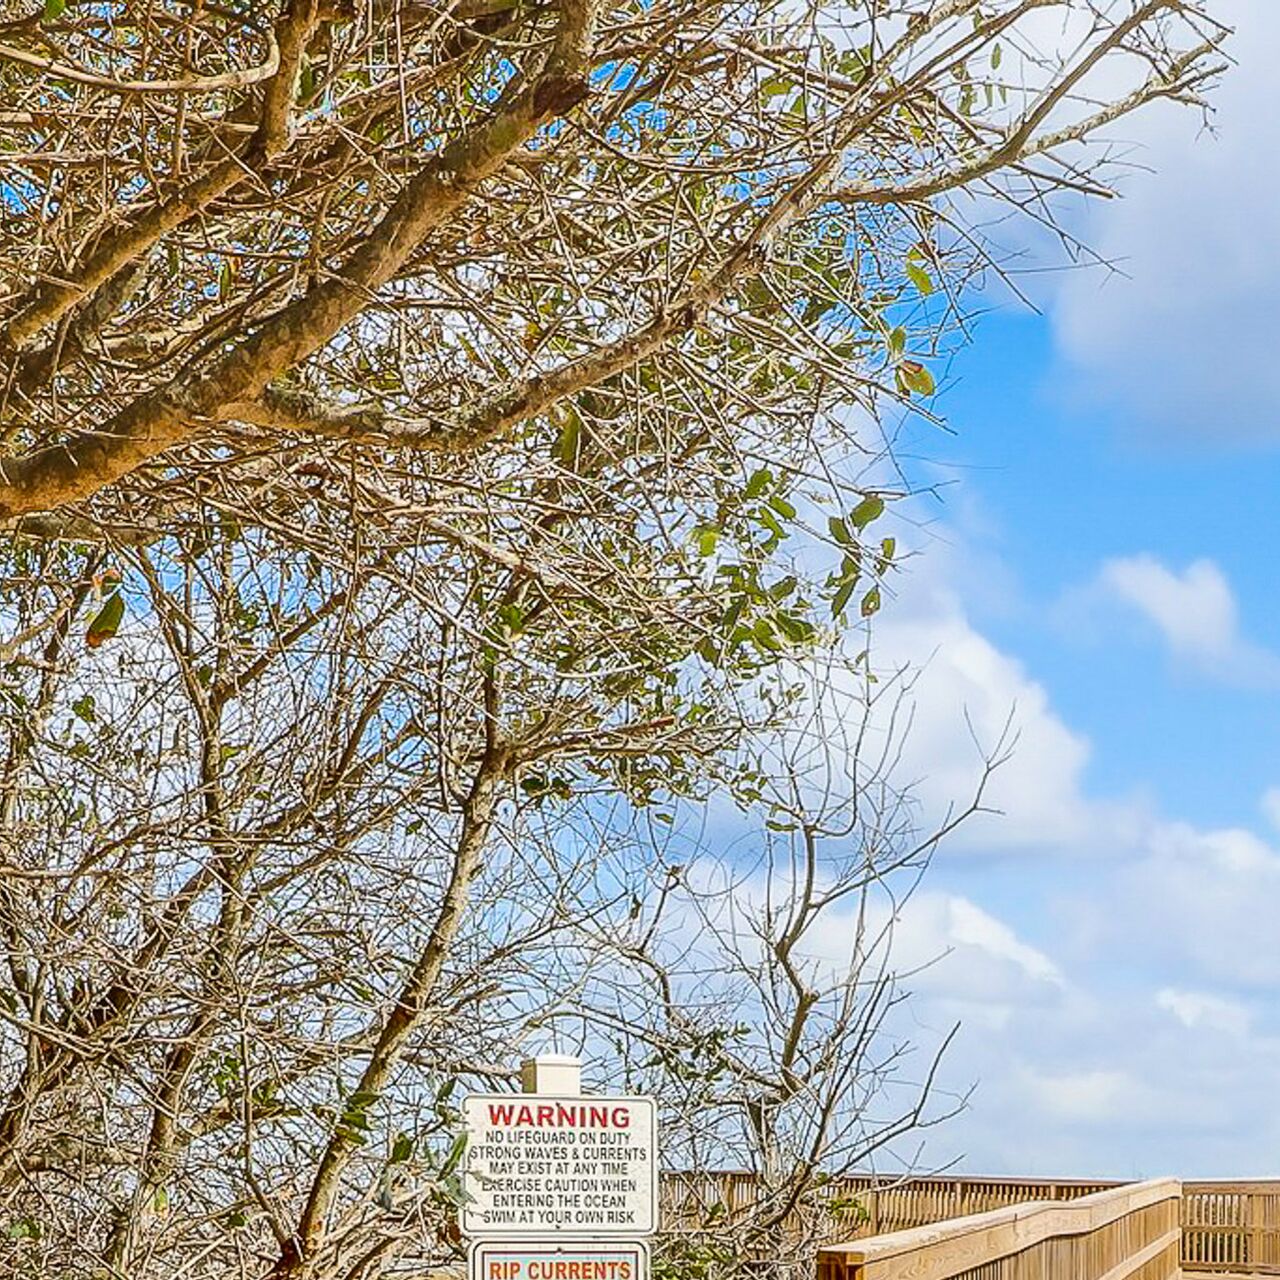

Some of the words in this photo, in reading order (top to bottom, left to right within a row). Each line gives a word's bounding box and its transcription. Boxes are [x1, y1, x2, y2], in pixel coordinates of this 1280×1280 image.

[488, 1104, 630, 1128] WARNING
[486, 1130, 504, 1144] NO
[507, 1131, 575, 1145] LIFEGUARD
[579, 1132, 596, 1145] ON
[600, 1132, 631, 1145] DUTY
[470, 1146, 521, 1160] STRONG
[524, 1147, 568, 1160] WAVES
[572, 1148, 580, 1160] &
[582, 1147, 647, 1161] CURRENTS
[489, 1162, 515, 1175] MAY
[518, 1162, 552, 1175] EXIST
[555, 1162, 570, 1175] AT
[574, 1162, 598, 1175] ANY
[601, 1162, 628, 1175] TIME
[482, 1178, 541, 1192] EXERCISE
[545, 1179, 598, 1192] CAUTION
[600, 1179, 636, 1192] WHEN
[493, 1194, 554, 1208] ENTERING
[557, 1195, 582, 1207] THE
[584, 1195, 626, 1208] OCEAN
[483, 1210, 516, 1224] SWIM
[519, 1211, 534, 1223] AT
[538, 1211, 572, 1224] YOUR
[575, 1211, 604, 1224] OWN
[607, 1211, 635, 1224] RISK
[489, 1262, 521, 1280] RIP
[528, 1262, 632, 1280] CURRENTS
